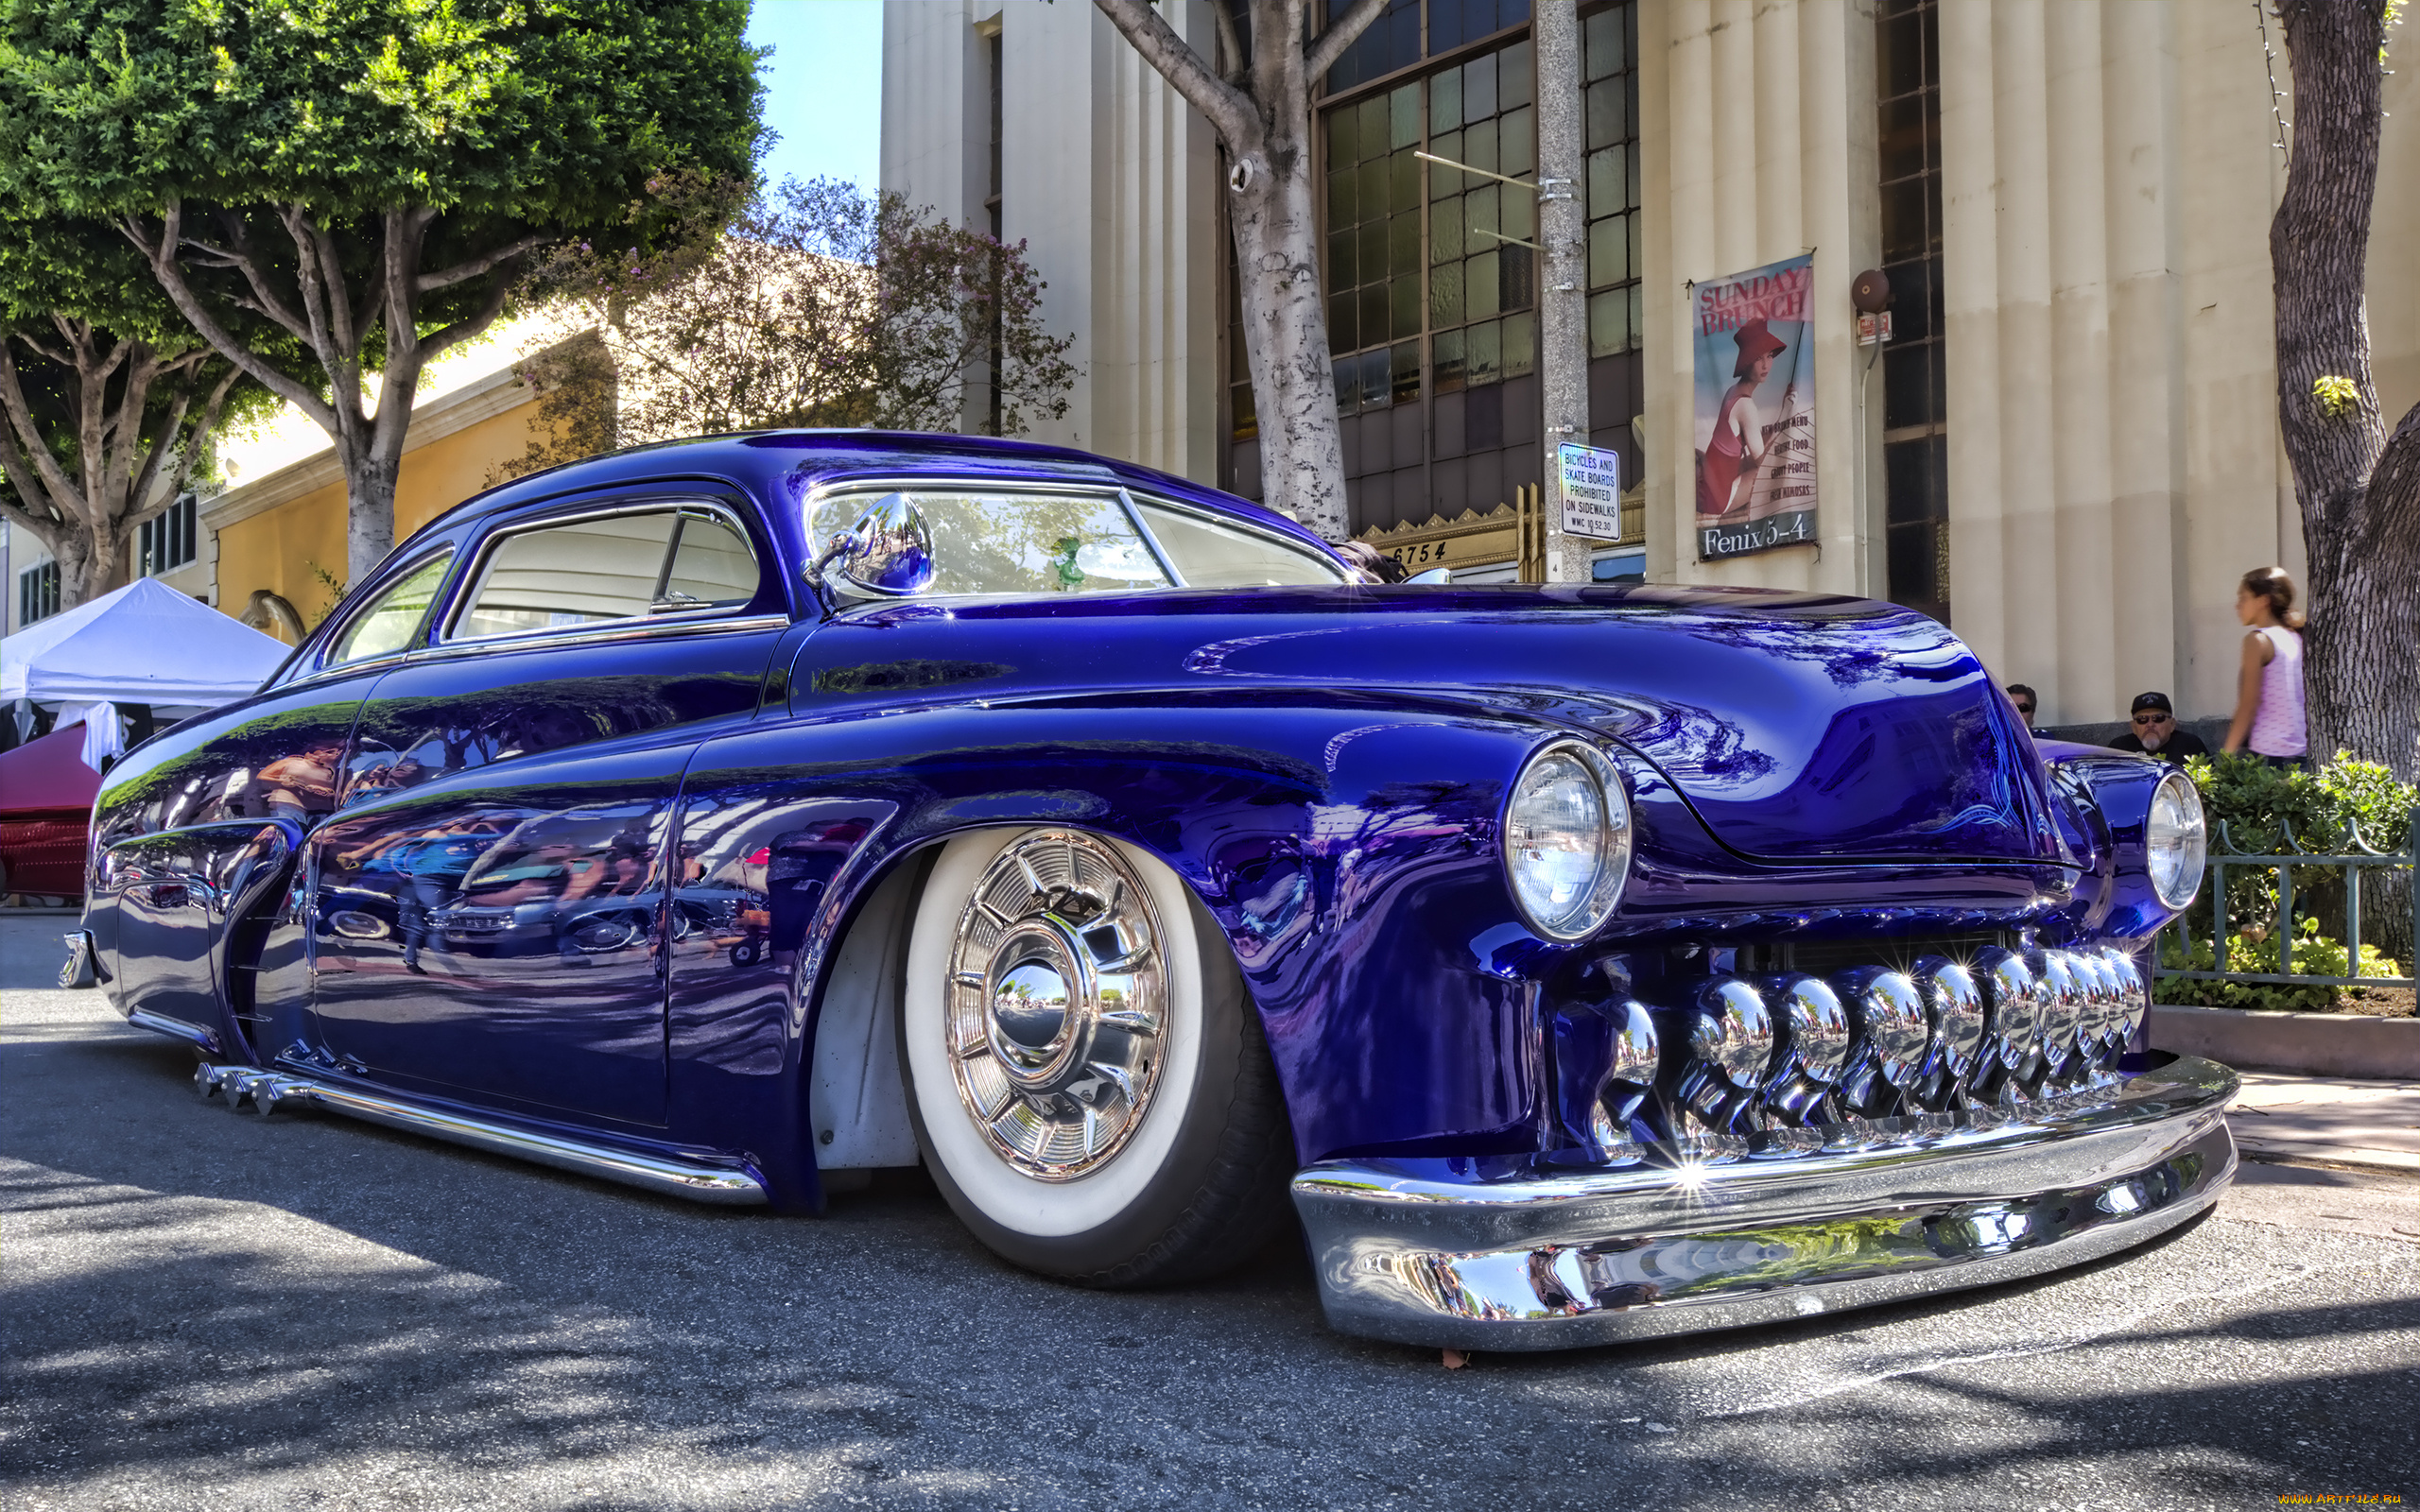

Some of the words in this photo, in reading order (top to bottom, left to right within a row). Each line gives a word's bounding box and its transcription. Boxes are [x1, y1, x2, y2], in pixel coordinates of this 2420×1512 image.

[1701, 266, 1805, 310] SUNDAY
[1701, 290, 1806, 336] BRUNCH
[1791, 416, 1808, 427] MENU
[1792, 438, 1809, 451] FOOD
[1564, 453, 1598, 470] BICYCLES
[1599, 459, 1613, 472] AND
[1788, 461, 1809, 474] PEOPLE
[1564, 468, 1585, 483] SKATE
[1588, 472, 1616, 488] BOARDS
[1570, 485, 1611, 502] PROHIBITED
[1782, 485, 1810, 498] MIMOSAS
[1565, 499, 1576, 511] ON
[1578, 502, 1616, 518] SIDEWALKS
[1571, 517, 1585, 527] WMC
[1703, 524, 1763, 556] Fenix
[1766, 513, 1807, 545] 5-4
[1393, 541, 1446, 565] 6754
